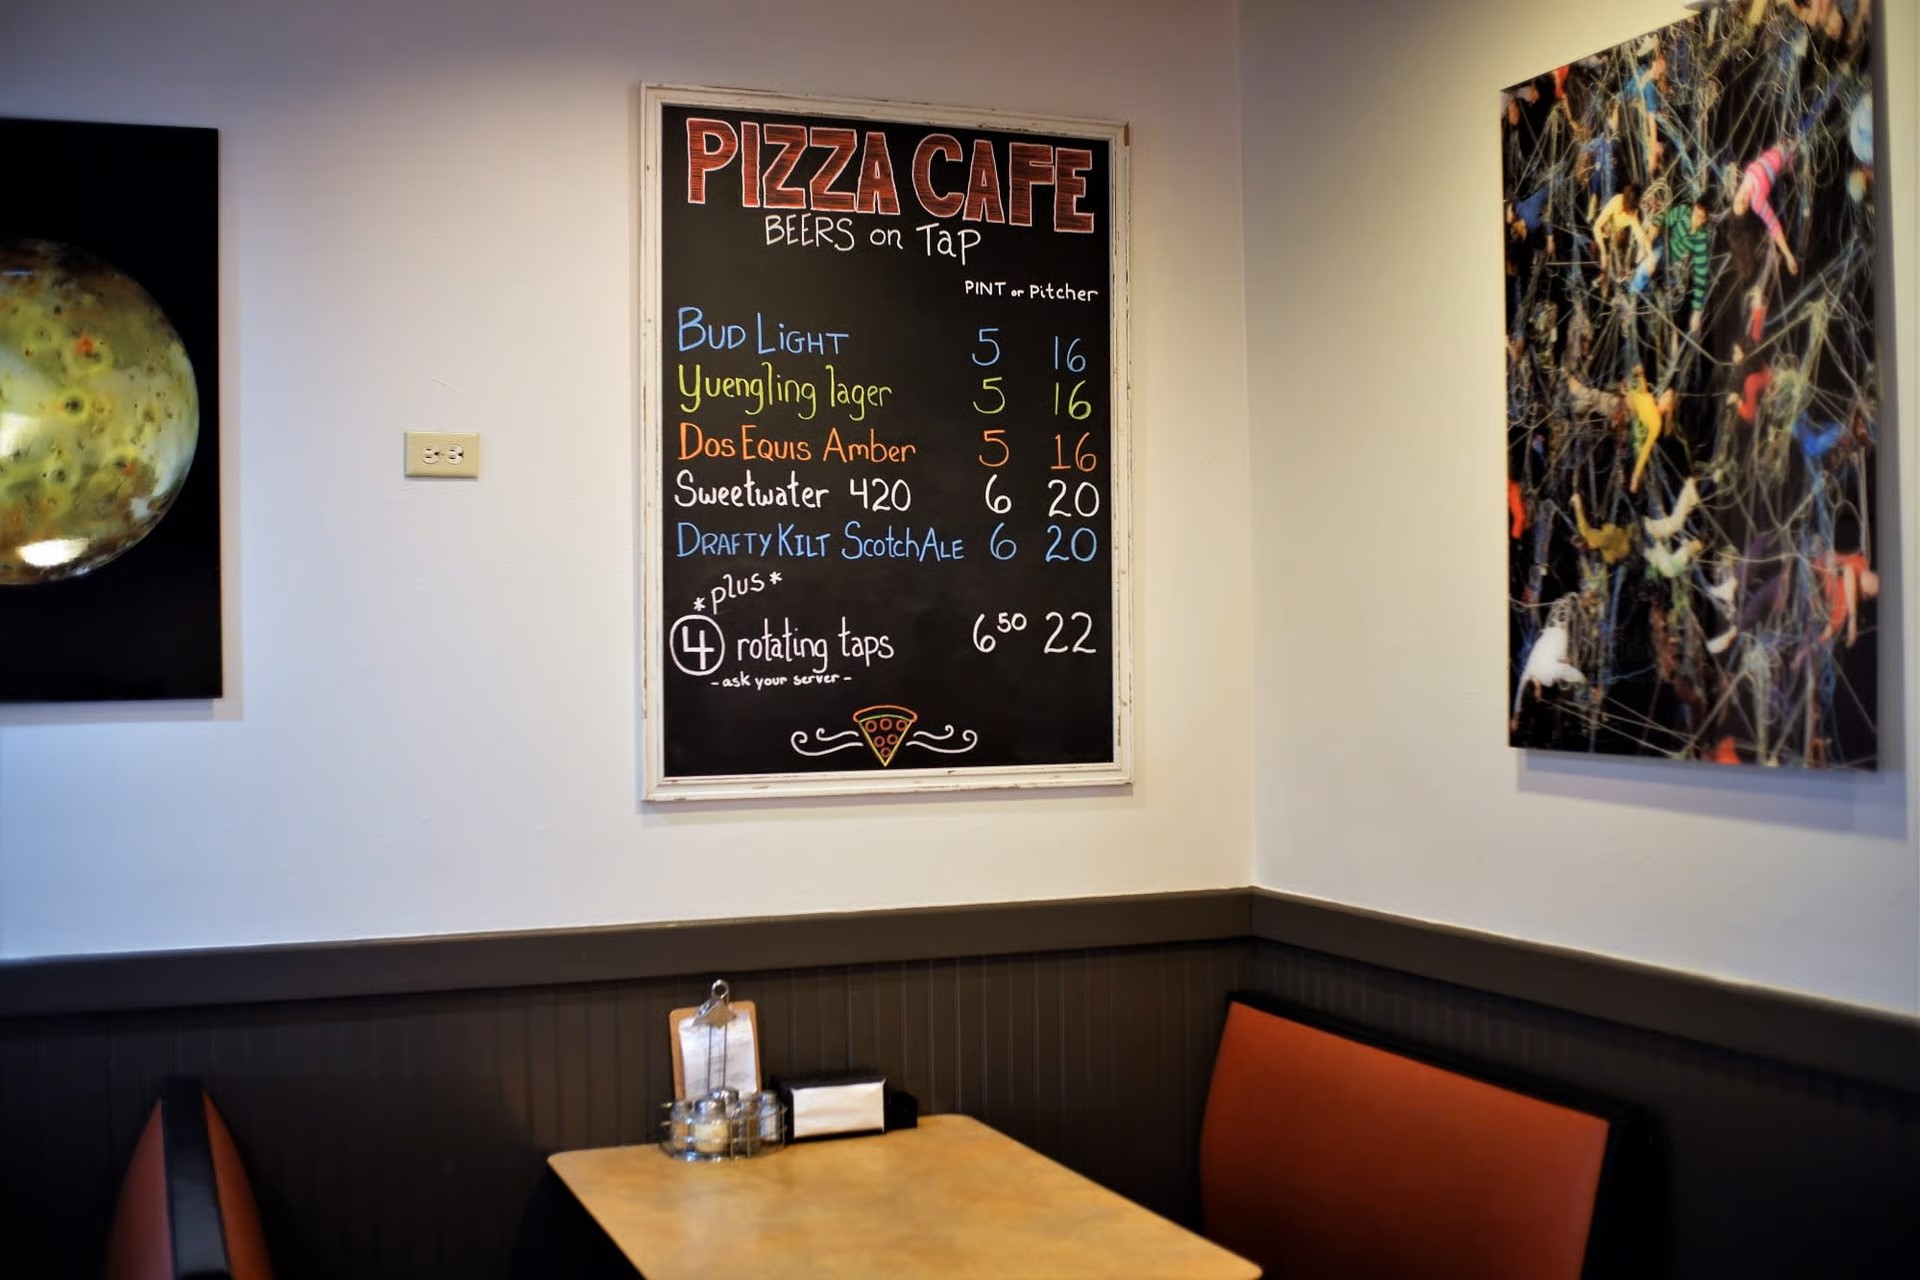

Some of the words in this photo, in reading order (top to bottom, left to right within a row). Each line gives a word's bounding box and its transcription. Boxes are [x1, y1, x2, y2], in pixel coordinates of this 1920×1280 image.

[686, 117, 900, 215] PIZZA
[912, 133, 1094, 233] CAFE
[764, 212, 854, 251] BEERS
[870, 227, 903, 249] on
[965, 280, 1006, 296] PINT
[1011, 288, 1024, 298] or
[1030, 284, 1098, 302] Pitcher
[972, 328, 1000, 366] 5
[1054, 335, 1086, 373] 16
[677, 361, 817, 420] Yuengling
[826, 364, 892, 421] lager
[973, 377, 1005, 415] 5
[1054, 380, 1092, 420] 16
[823, 427, 916, 463] Amber
[979, 429, 1009, 467] 5
[1050, 433, 1097, 472] 16
[674, 470, 829, 508] Sweetwater
[849, 478, 911, 512] 420
[985, 474, 1012, 514] 6
[1047, 480, 1099, 517] 20
[676, 521, 772, 558] DRAFTY
[778, 523, 831, 556] KILT
[990, 523, 1017, 560] 6
[1045, 526, 1097, 562] 20
[682, 626, 714, 670] 4
[738, 617, 828, 673] rotating
[838, 617, 894, 667] taps
[1044, 612, 1096, 654] 22
[754, 675, 787, 690] your
